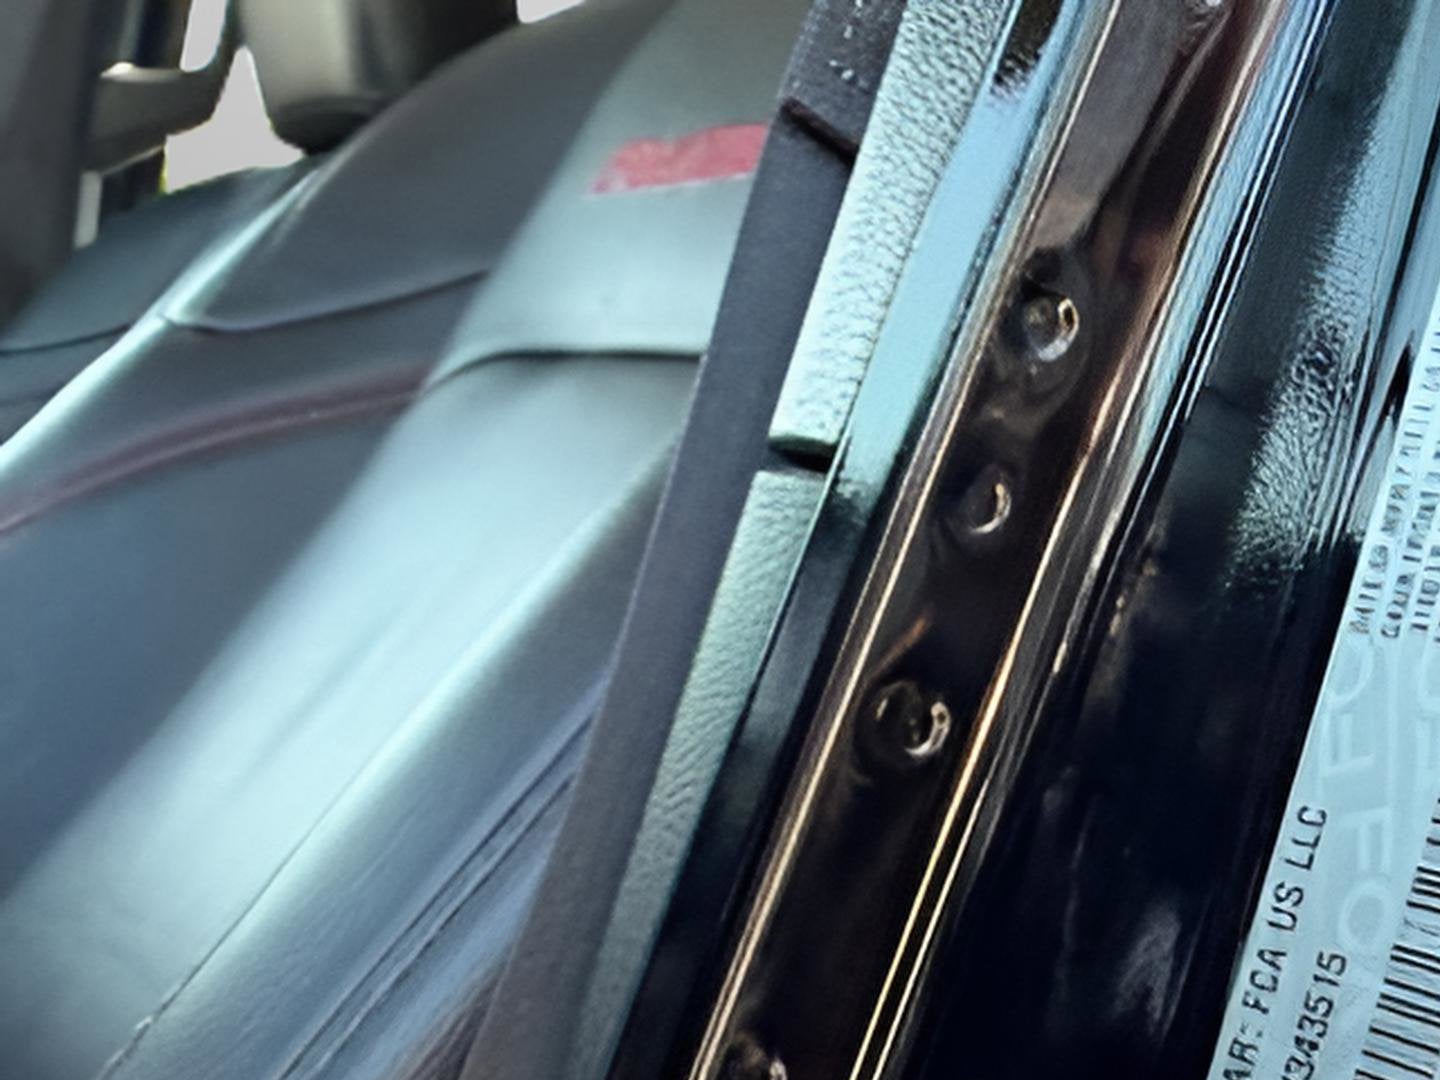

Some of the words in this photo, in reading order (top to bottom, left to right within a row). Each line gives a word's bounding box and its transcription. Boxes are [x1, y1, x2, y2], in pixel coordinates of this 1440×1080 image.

[1284, 805, 1327, 871] LLC
[1267, 881, 1304, 931] US
[1241, 949, 1287, 1015] FCA
